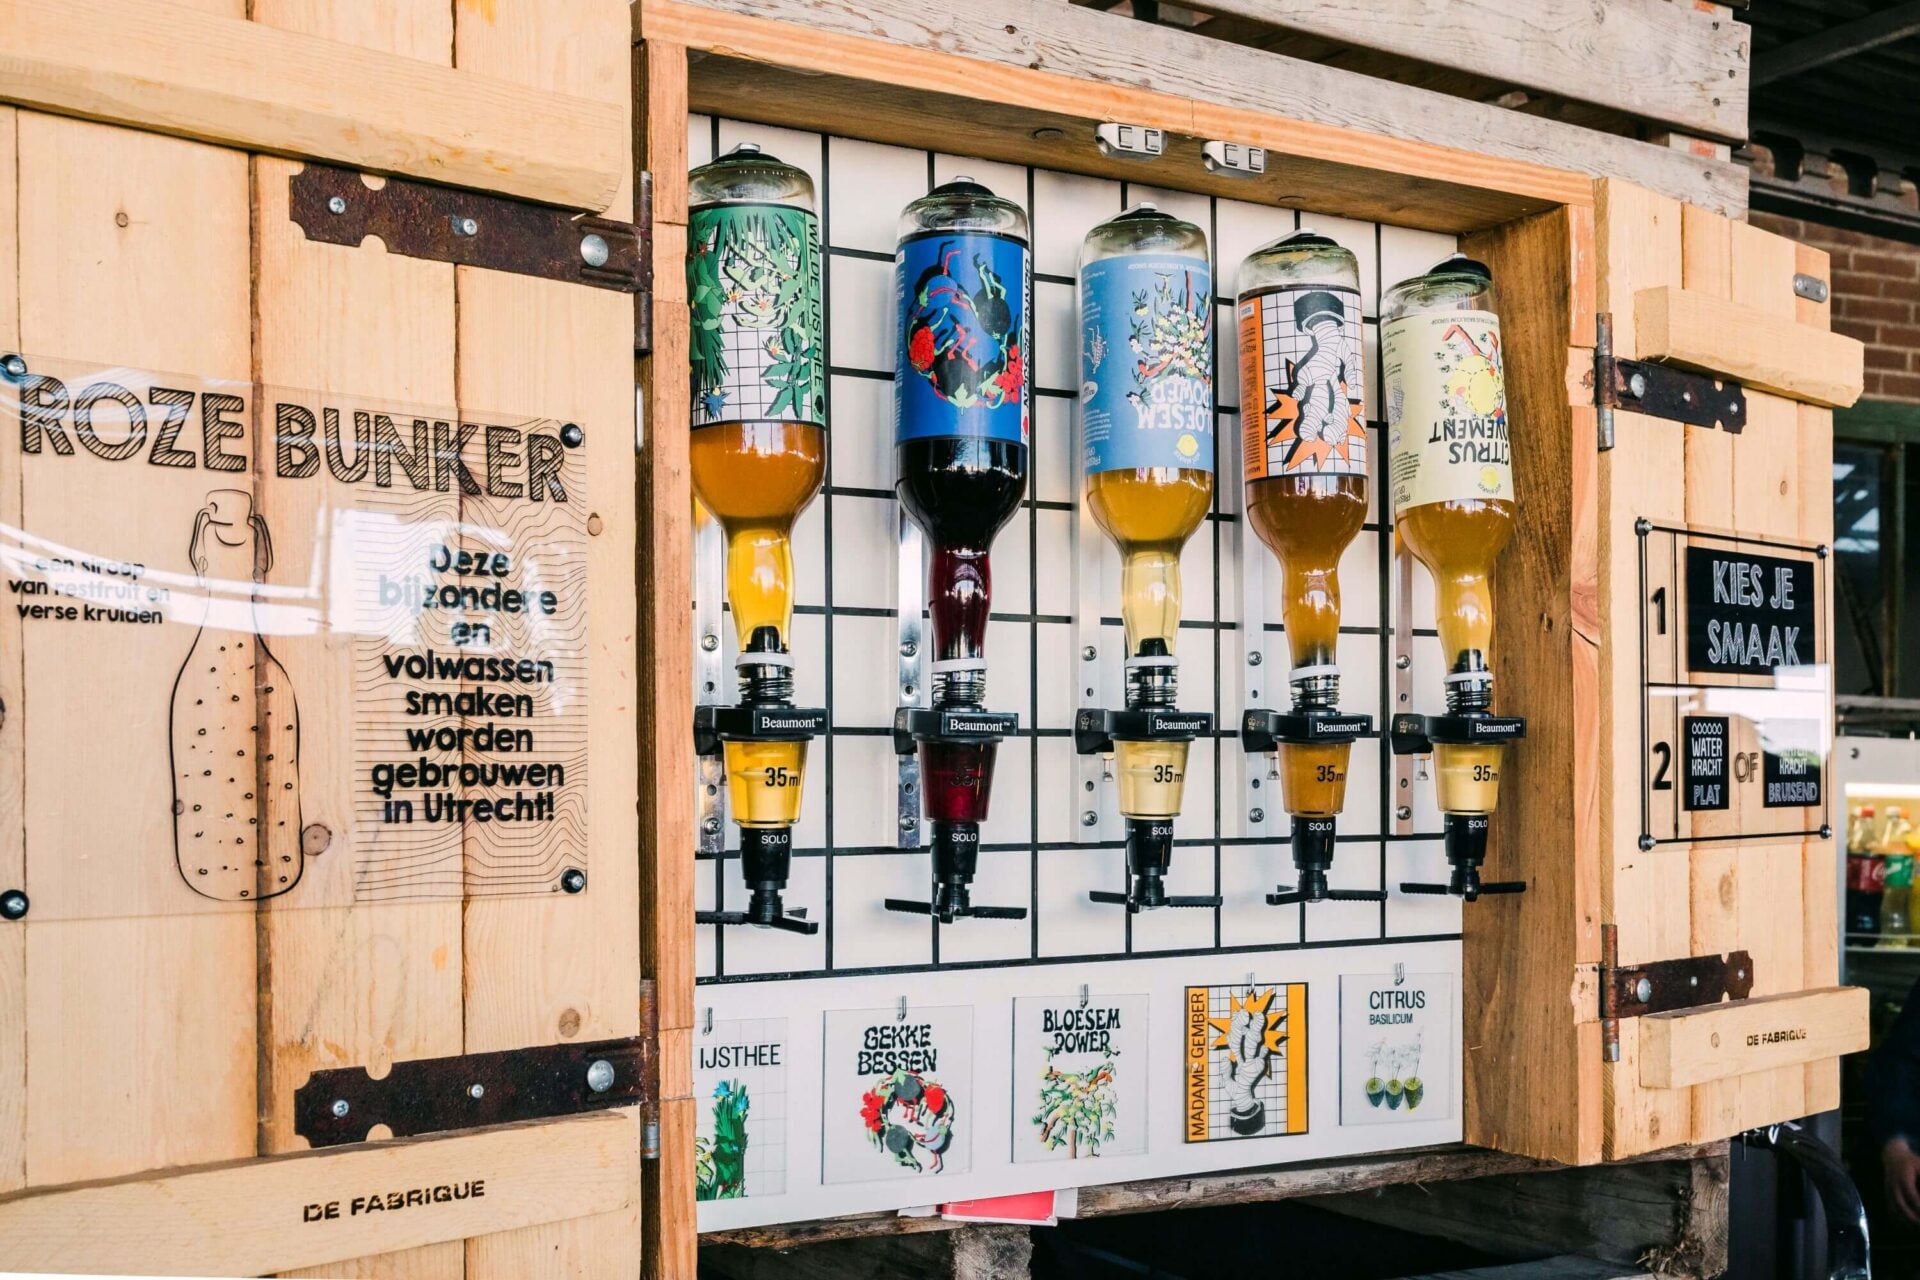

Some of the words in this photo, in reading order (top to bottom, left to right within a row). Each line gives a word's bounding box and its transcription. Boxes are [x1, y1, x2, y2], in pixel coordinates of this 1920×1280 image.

[807, 222, 820, 285] WILDE
[811, 298, 825, 388] IJSTHEE
[18, 373, 248, 473] ROZE
[275, 402, 569, 503] BUNKER
[429, 543, 510, 578] Deze
[8, 579, 48, 596] van
[378, 574, 559, 616] bijzondere
[1712, 560, 1764, 608] KIES
[1769, 566, 1795, 610] JE
[16, 604, 78, 620] verse
[83, 604, 163, 624] kruiden
[1651, 586, 1667, 635] 1
[450, 621, 491, 647] en
[1706, 618, 1801, 667] SMAAK
[382, 648, 555, 683] volwassen
[405, 686, 533, 717] smaken
[405, 722, 533, 752] worden
[1691, 737, 1724, 758] WATER
[371, 756, 565, 796] gebrouwen
[1652, 741, 1672, 791] 2
[1691, 758, 1723, 777] KRACHT
[1734, 752, 1759, 783] OF
[1779, 758, 1808, 776] KRACHT
[1693, 784, 1721, 806] PLAT
[1768, 782, 1818, 803] BRUISEND
[383, 792, 413, 824] in
[423, 790, 556, 824] Utrecht!
[1308, 822, 1333, 831] SOLO
[1468, 819, 1488, 828] SOLO
[761, 834, 788, 844] SOLO
[951, 832, 977, 843] SOLO
[1368, 990, 1426, 1010] CITRUS
[1042, 1008, 1121, 1033] BLOESEM
[1190, 992, 1206, 1059] GEMBER
[1368, 1013, 1414, 1026] BASILICUM
[863, 1024, 932, 1051] GEKKE
[1054, 1030, 1111, 1054] POWER
[1746, 1034, 1760, 1047] DE
[699, 1044, 782, 1070] IJSTHEE
[857, 1048, 938, 1076] BESSEN
[1191, 1062, 1206, 1137] MADAME
[303, 1201, 340, 1222] DE
[350, 1180, 485, 1217] FABRIQUE
